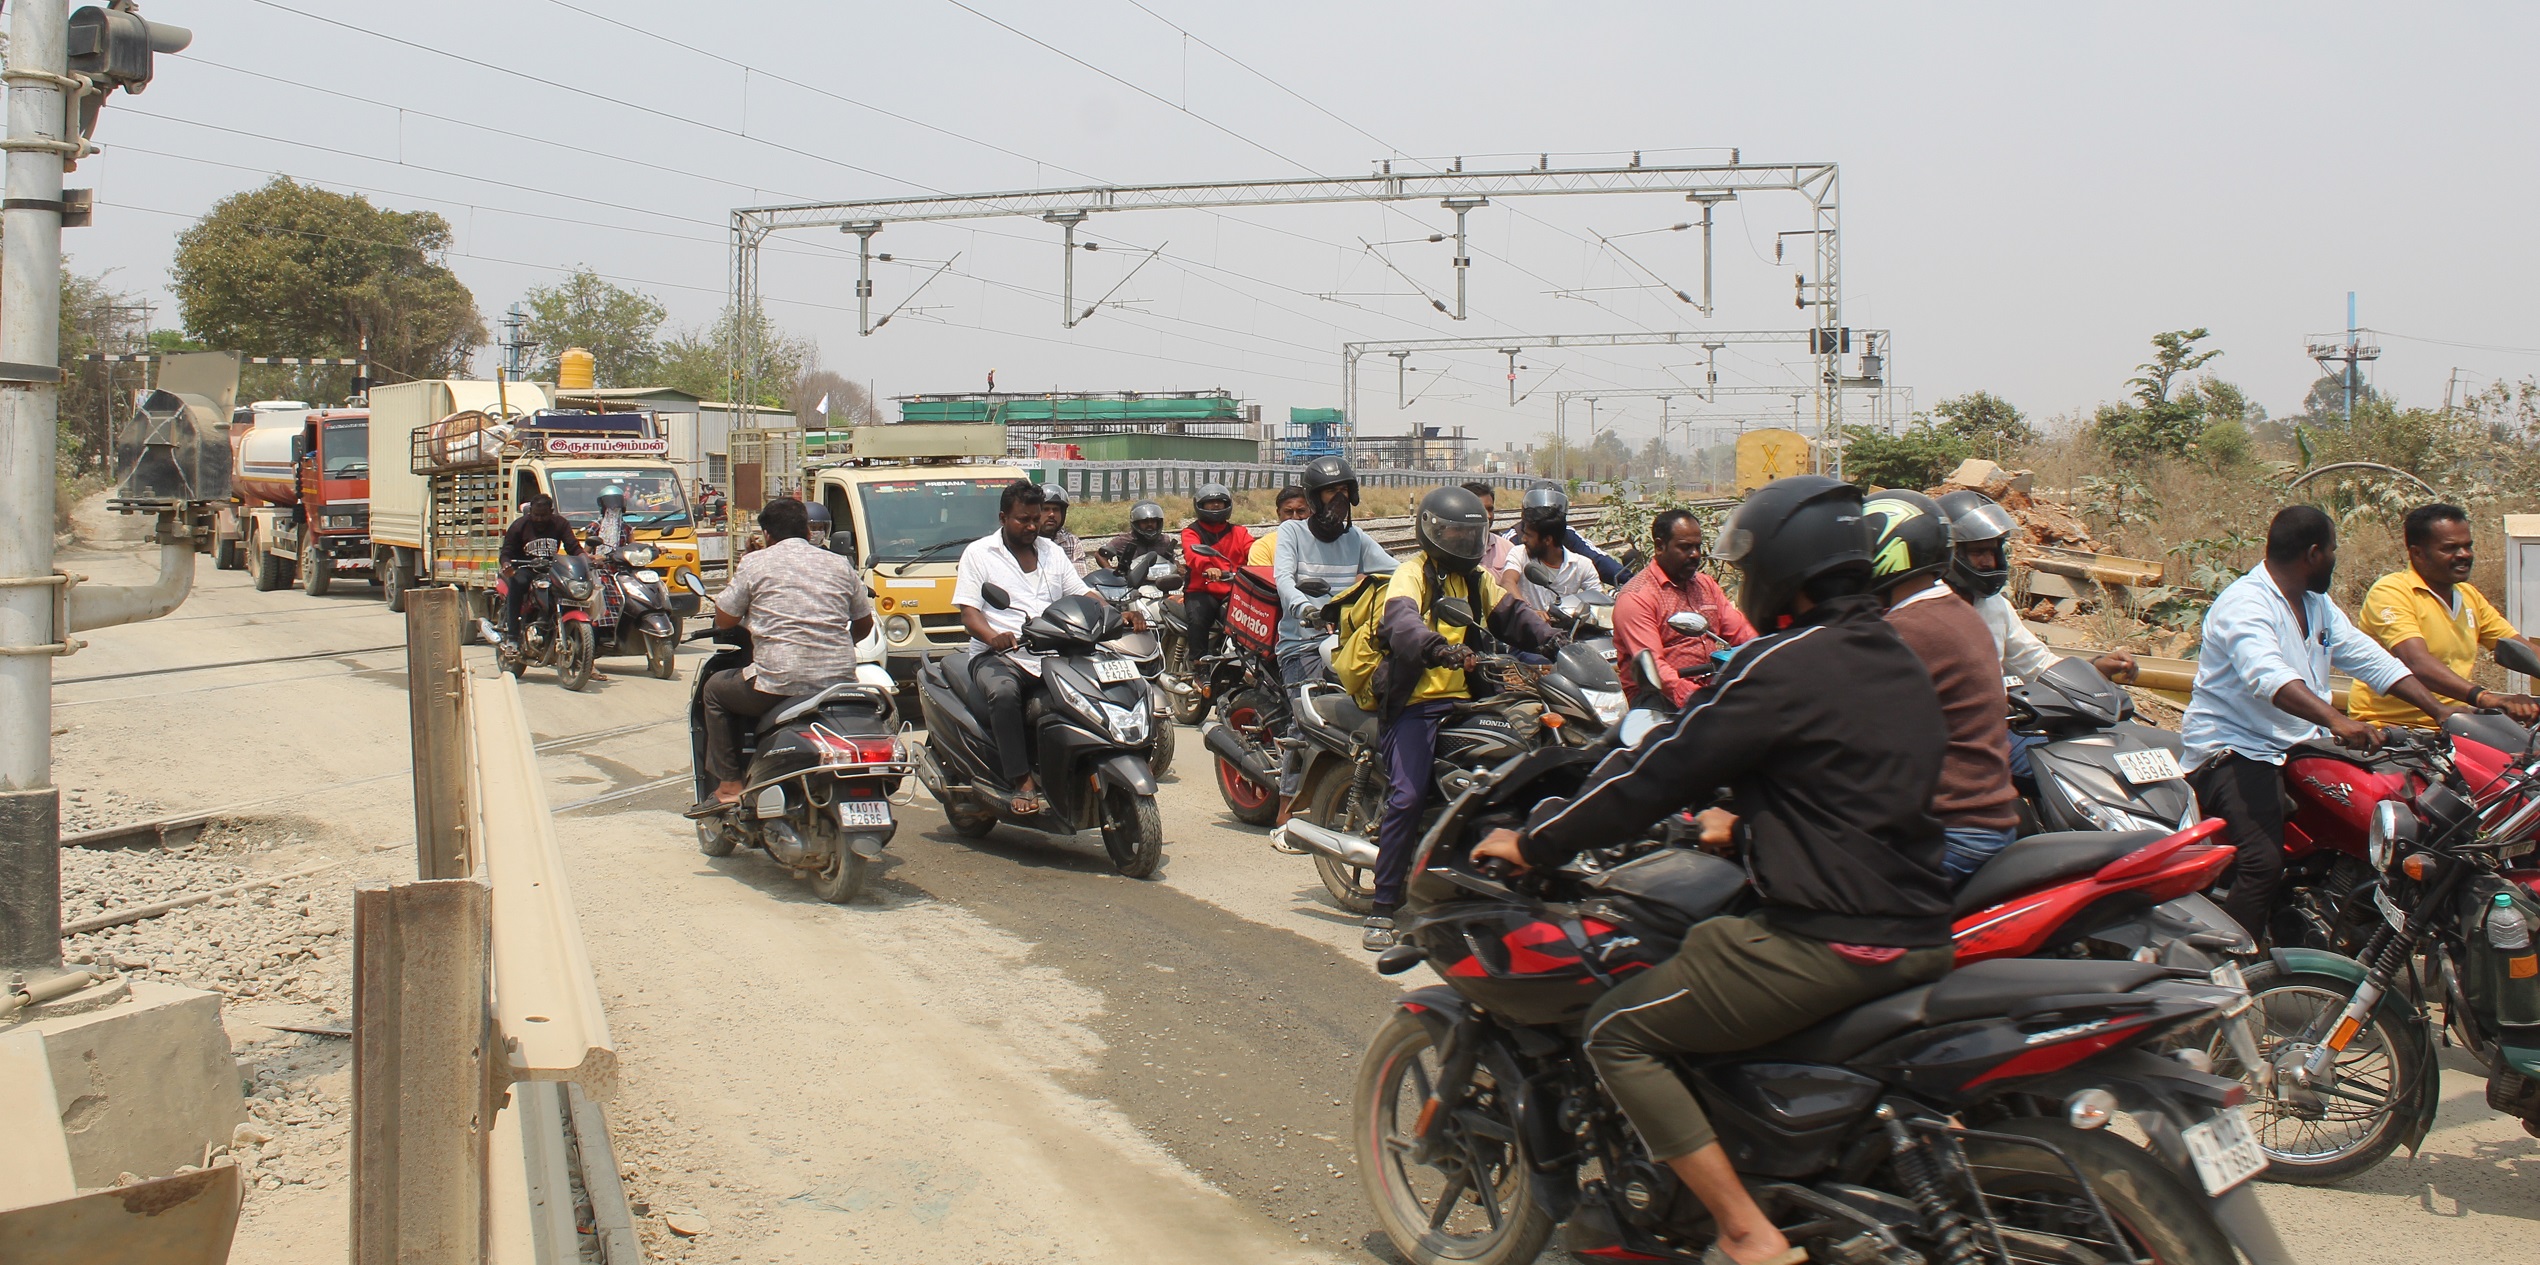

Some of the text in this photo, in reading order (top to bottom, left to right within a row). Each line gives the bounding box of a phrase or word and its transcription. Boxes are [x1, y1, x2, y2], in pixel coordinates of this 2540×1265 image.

[551, 439, 665, 453] இருசாய்அம்மன்
[901, 600, 918, 608] ACE
[1231, 606, 1268, 637] zomato
[1101, 660, 1129, 671] KA51J
[1105, 669, 1134, 681] F4276
[1479, 719, 1512, 729] HONDA
[2125, 750, 2166, 768] KA51H
[850, 802, 880, 814] KA01K
[851, 813, 883, 825] F2686
